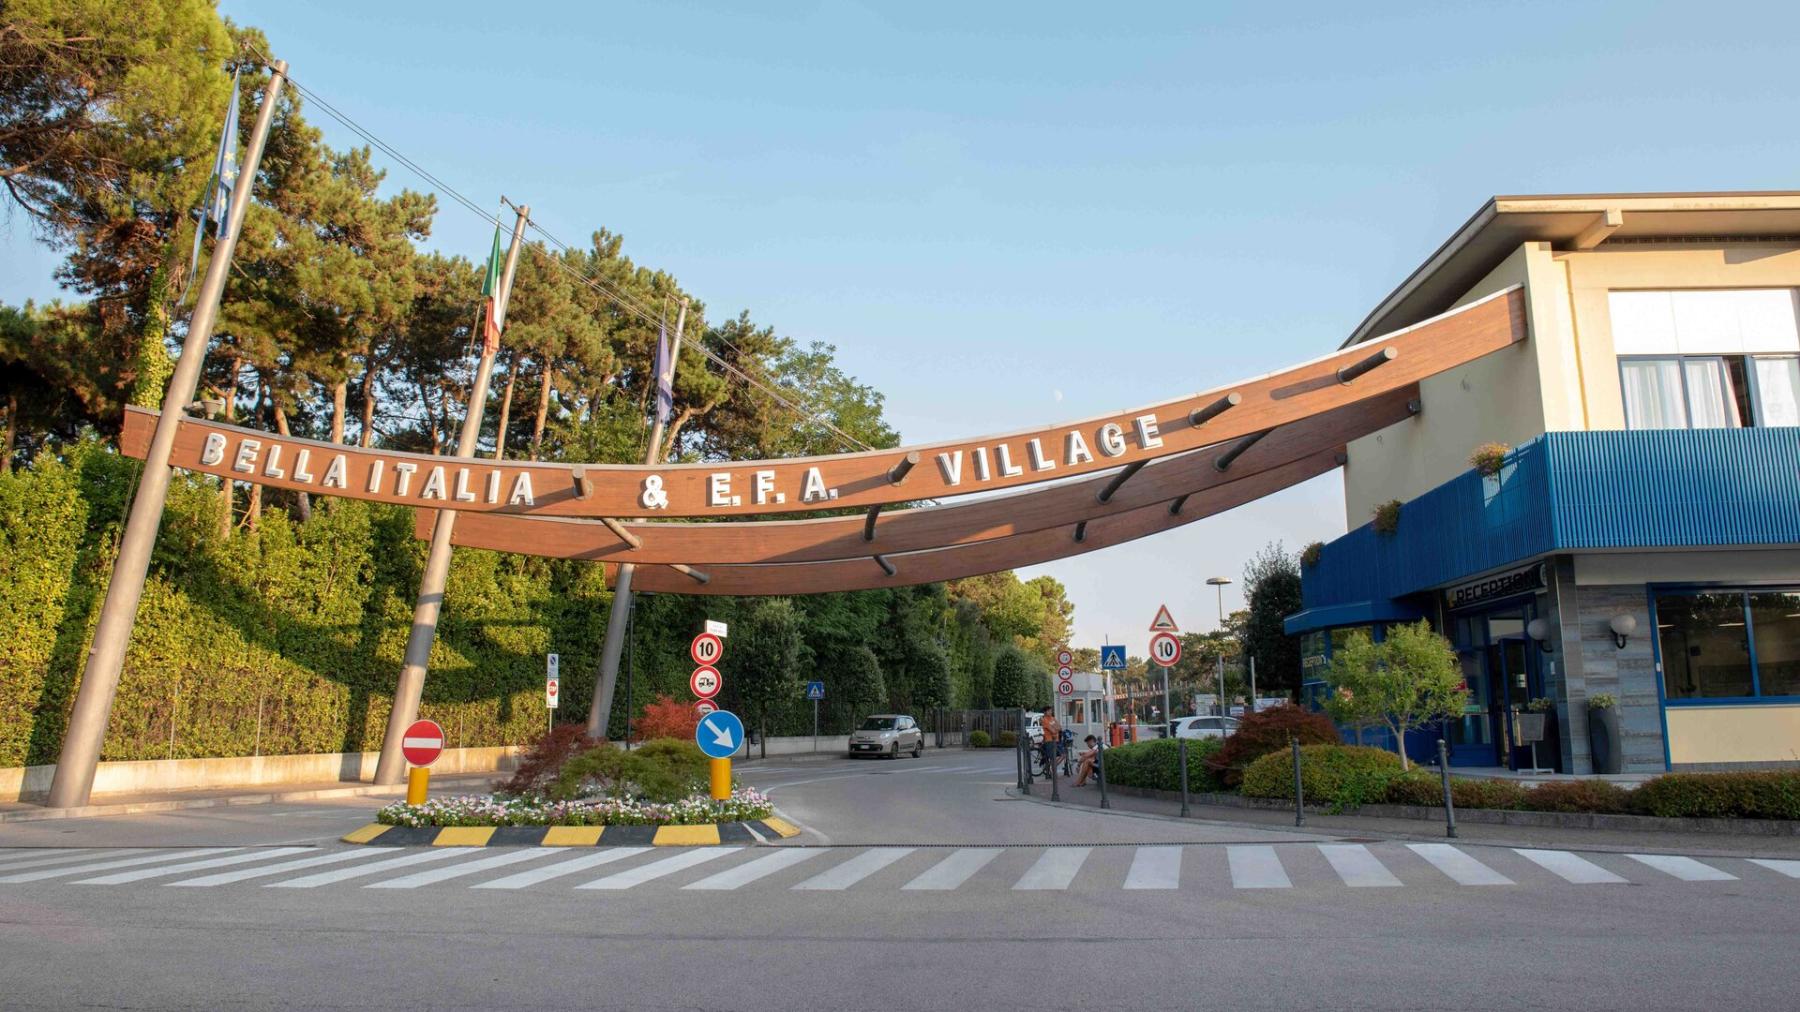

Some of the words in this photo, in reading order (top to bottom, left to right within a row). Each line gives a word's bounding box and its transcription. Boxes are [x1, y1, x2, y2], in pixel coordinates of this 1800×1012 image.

[202, 433, 347, 489] BELLA
[369, 459, 535, 505] ITALIA
[642, 475, 669, 510] &
[938, 414, 1164, 486] VILLAGE
[699, 642, 714, 657] 10
[1158, 641, 1173, 657] 10
[1062, 684, 1070, 692] 10
